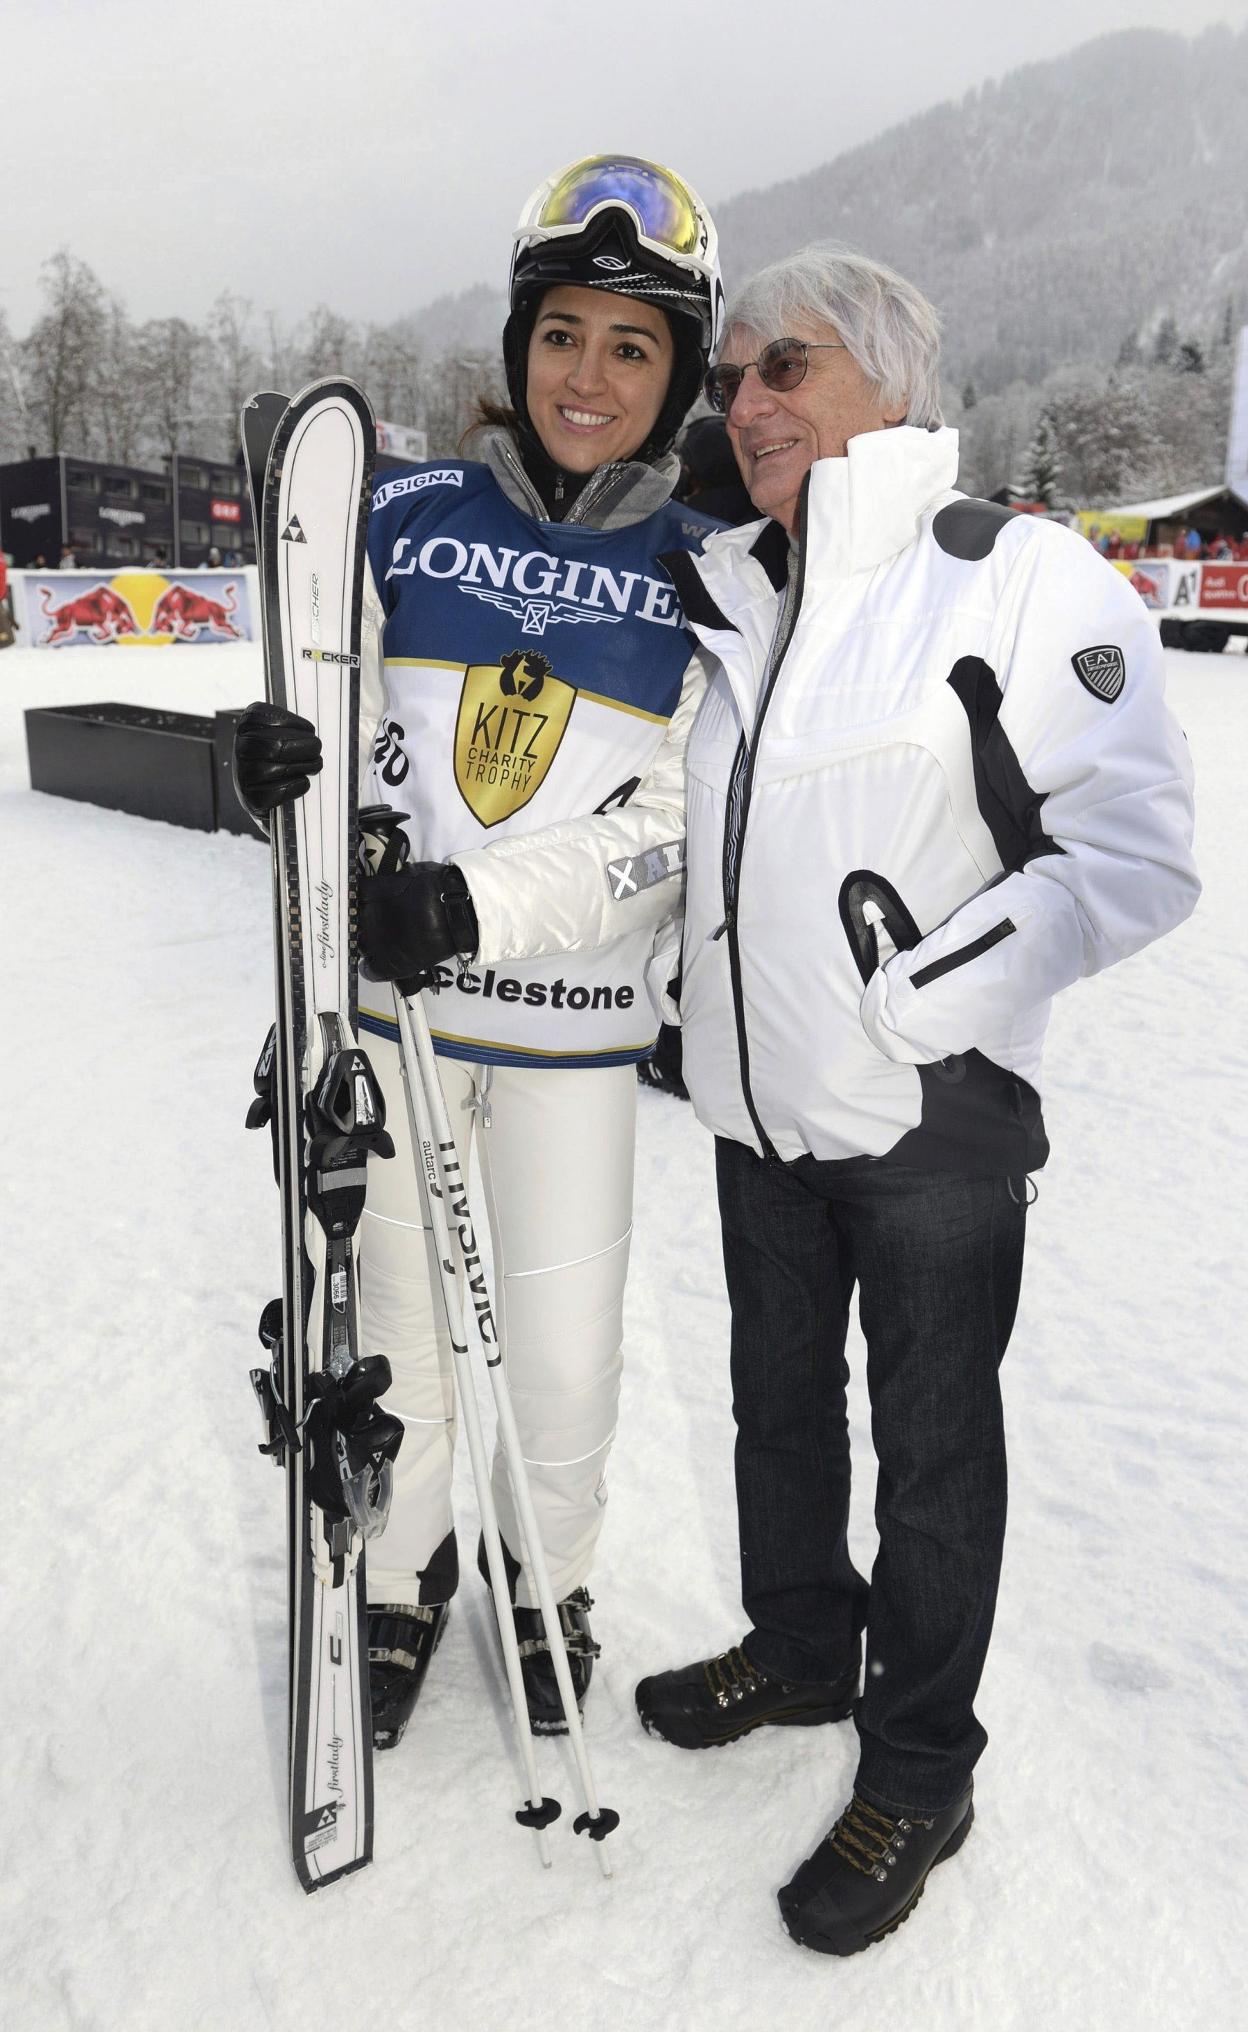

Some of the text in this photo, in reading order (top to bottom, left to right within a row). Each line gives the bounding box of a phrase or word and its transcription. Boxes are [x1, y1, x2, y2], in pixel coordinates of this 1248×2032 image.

[391, 470, 461, 495] SIGNA
[384, 537, 688, 631] LONGINE
[1084, 650, 1116, 667] EA7
[470, 702, 549, 760] KITZ
[466, 761, 532, 793] TROPHY
[468, 747, 536, 773] CHARITY
[418, 964, 635, 1011] cclestone
[422, 1140, 437, 1181] autarc
